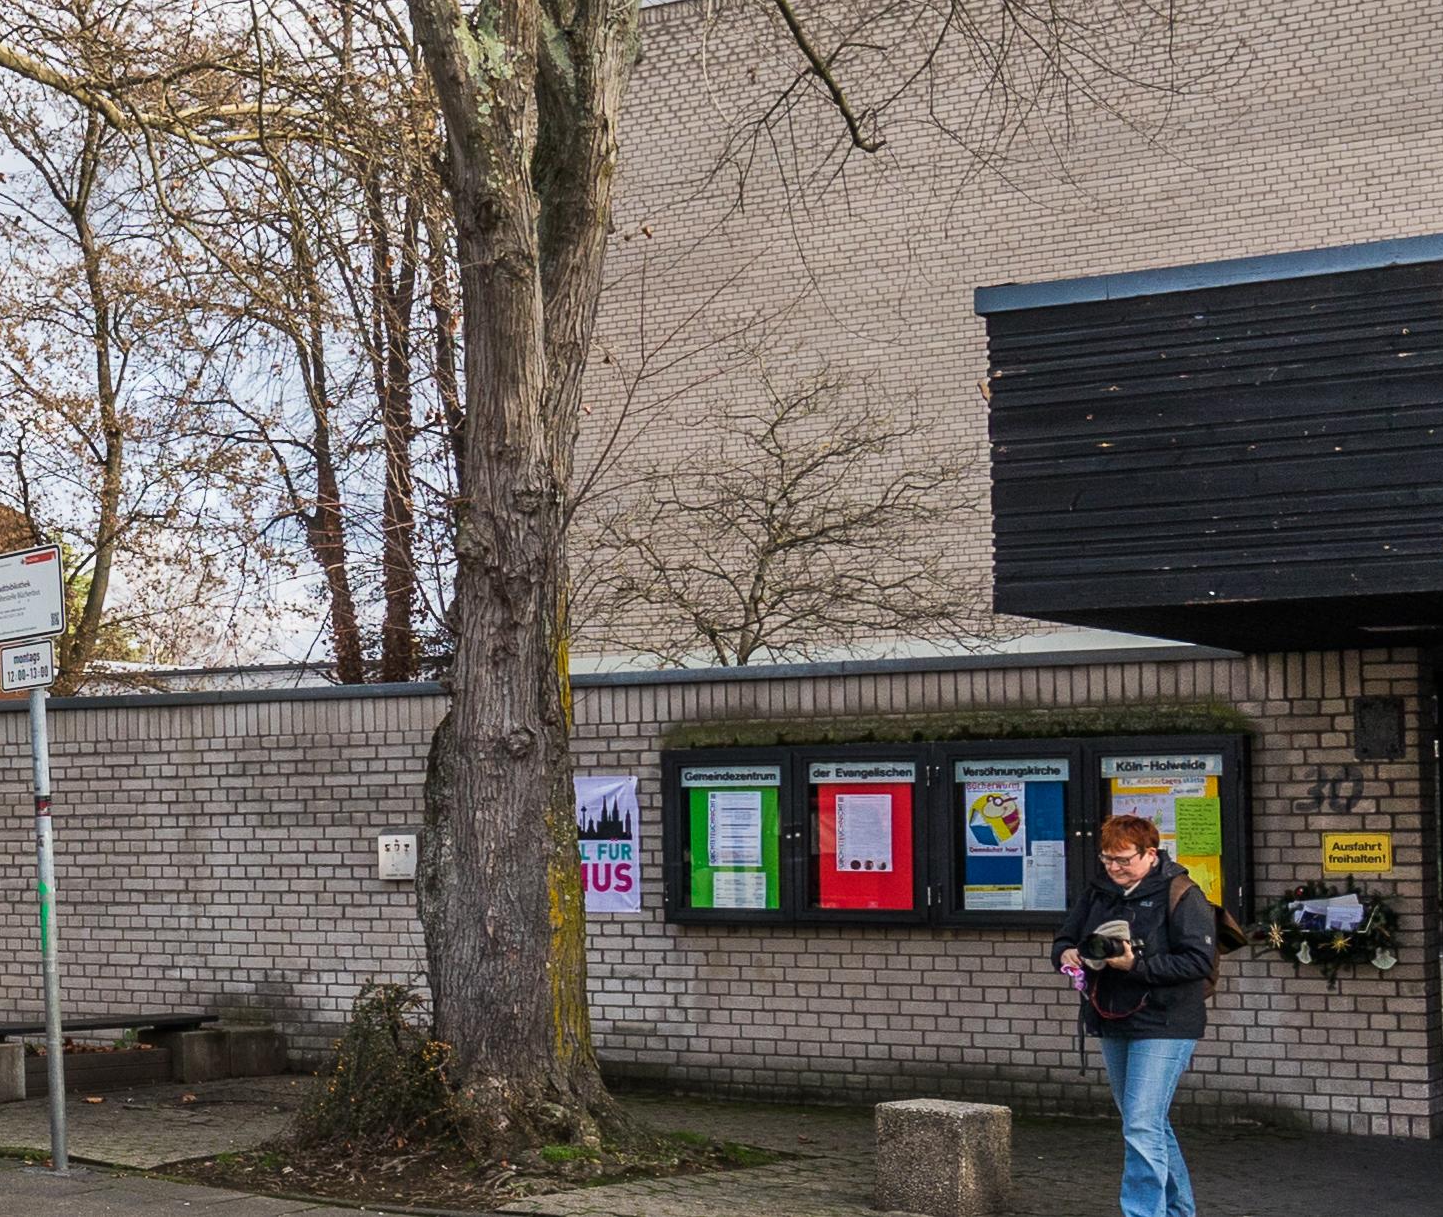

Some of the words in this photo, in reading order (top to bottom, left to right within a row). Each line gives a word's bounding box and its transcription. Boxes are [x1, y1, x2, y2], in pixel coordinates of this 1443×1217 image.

[13, 653, 40, 664] montags
[962, 765, 1061, 778] Versöhnungskirche
[1116, 759, 1207, 772] Köln-Holweide
[684, 771, 777, 782] Gemeindezentrum
[812, 768, 831, 778] der
[835, 767, 913, 780] Evangelischen
[1293, 765, 1365, 814] 30
[579, 843, 590, 861] L
[597, 837, 632, 861] FÜR
[1332, 841, 1382, 852] Ausfahrt
[1328, 854, 1386, 864] freihalten!
